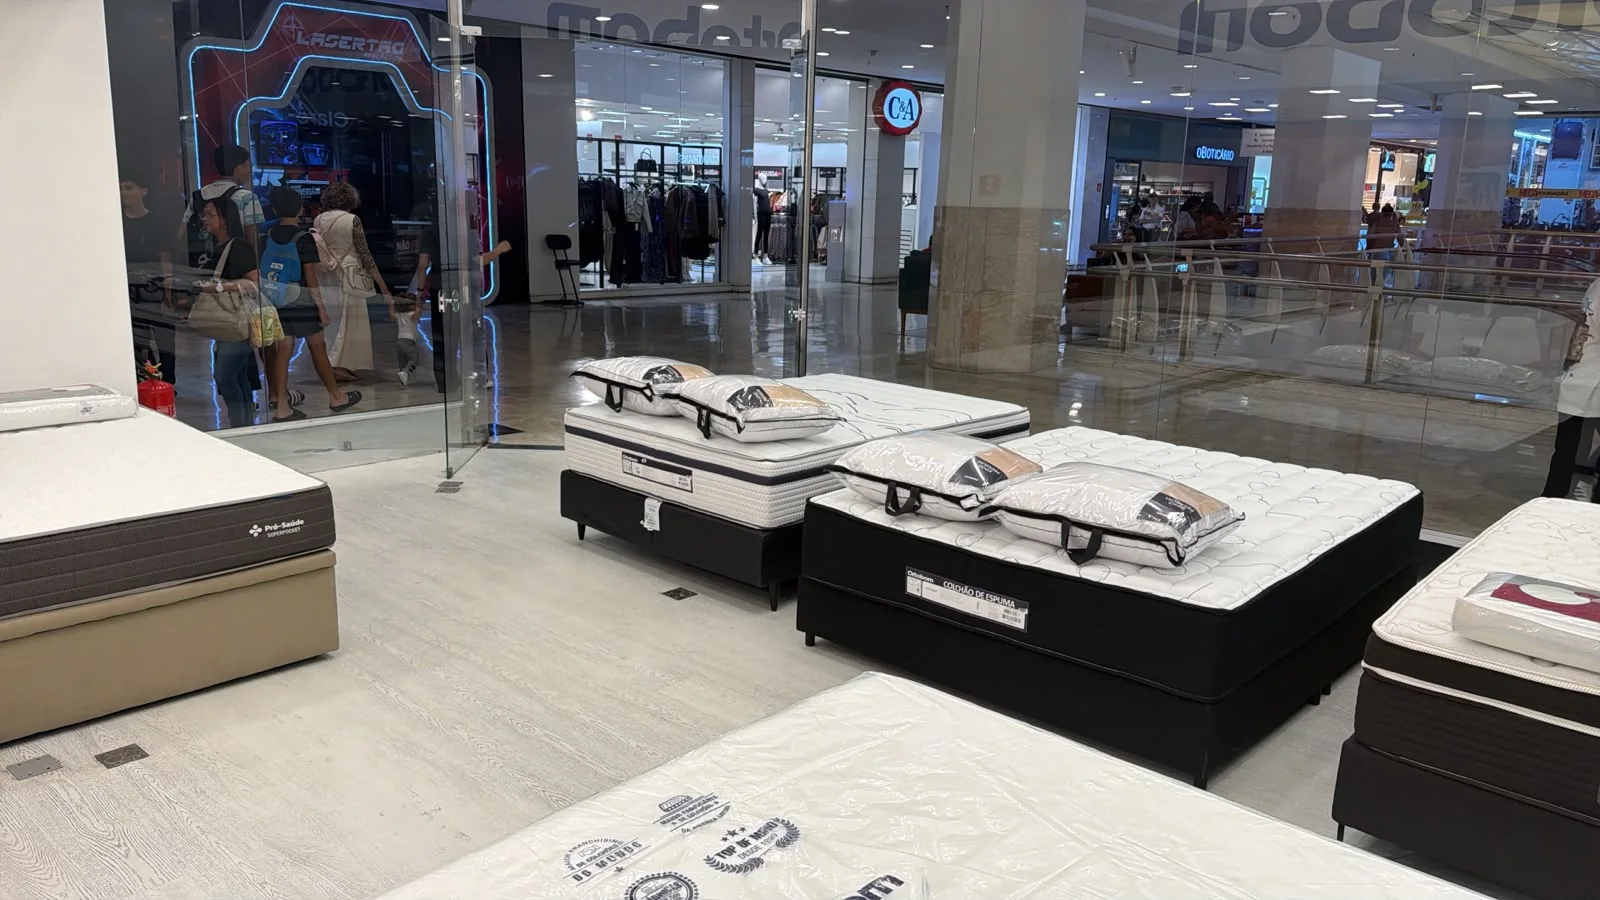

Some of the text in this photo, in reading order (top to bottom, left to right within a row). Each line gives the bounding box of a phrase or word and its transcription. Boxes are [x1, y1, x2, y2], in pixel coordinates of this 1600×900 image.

[888, 96, 914, 121] C&A
[264, 519, 304, 532] Pró-Saúde
[943, 580, 974, 597] COLCHÃO
[975, 590, 985, 599] DE
[985, 593, 1016, 609] ESPUMA
[714, 845, 737, 859] TOP
[736, 838, 751, 848] OF
[572, 841, 642, 882] DO MUNDO
